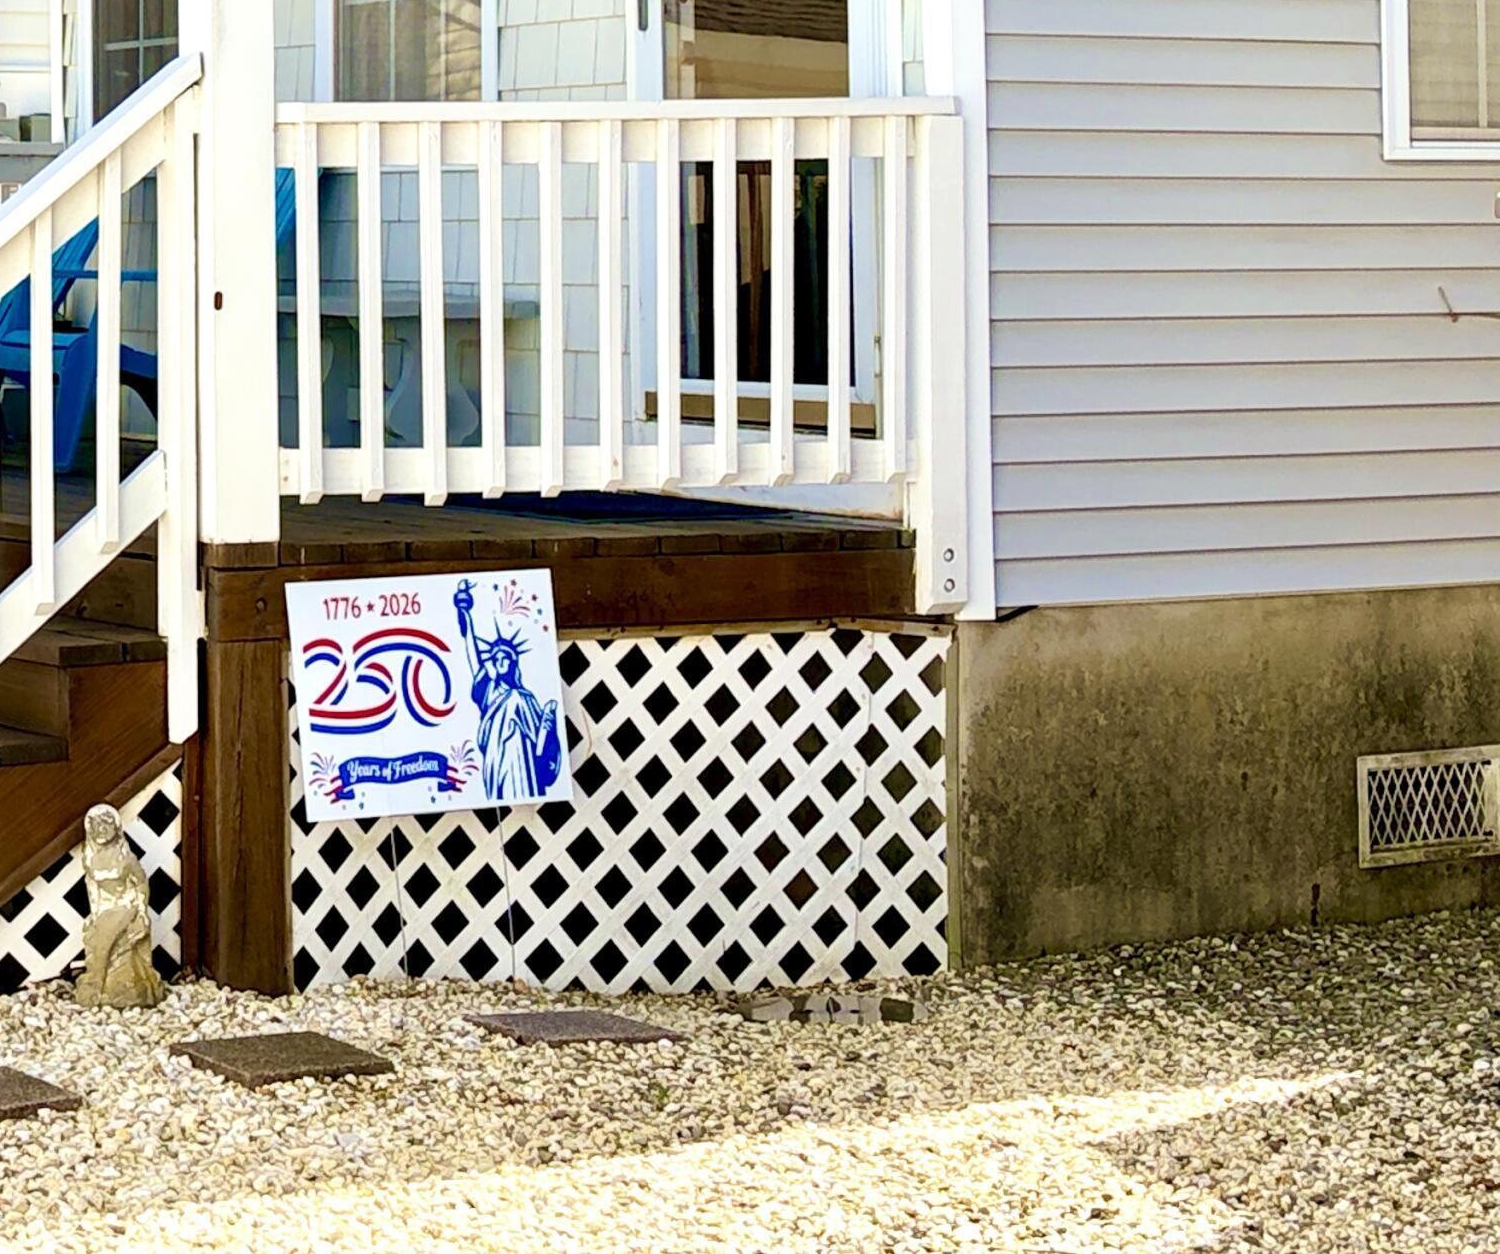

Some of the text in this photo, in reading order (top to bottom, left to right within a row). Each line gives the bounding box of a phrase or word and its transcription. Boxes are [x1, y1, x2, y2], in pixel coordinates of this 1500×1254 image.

[323, 592, 422, 621] 1776 2026
[303, 627, 457, 735] 250
[347, 755, 440, 783] Years of Freedom
